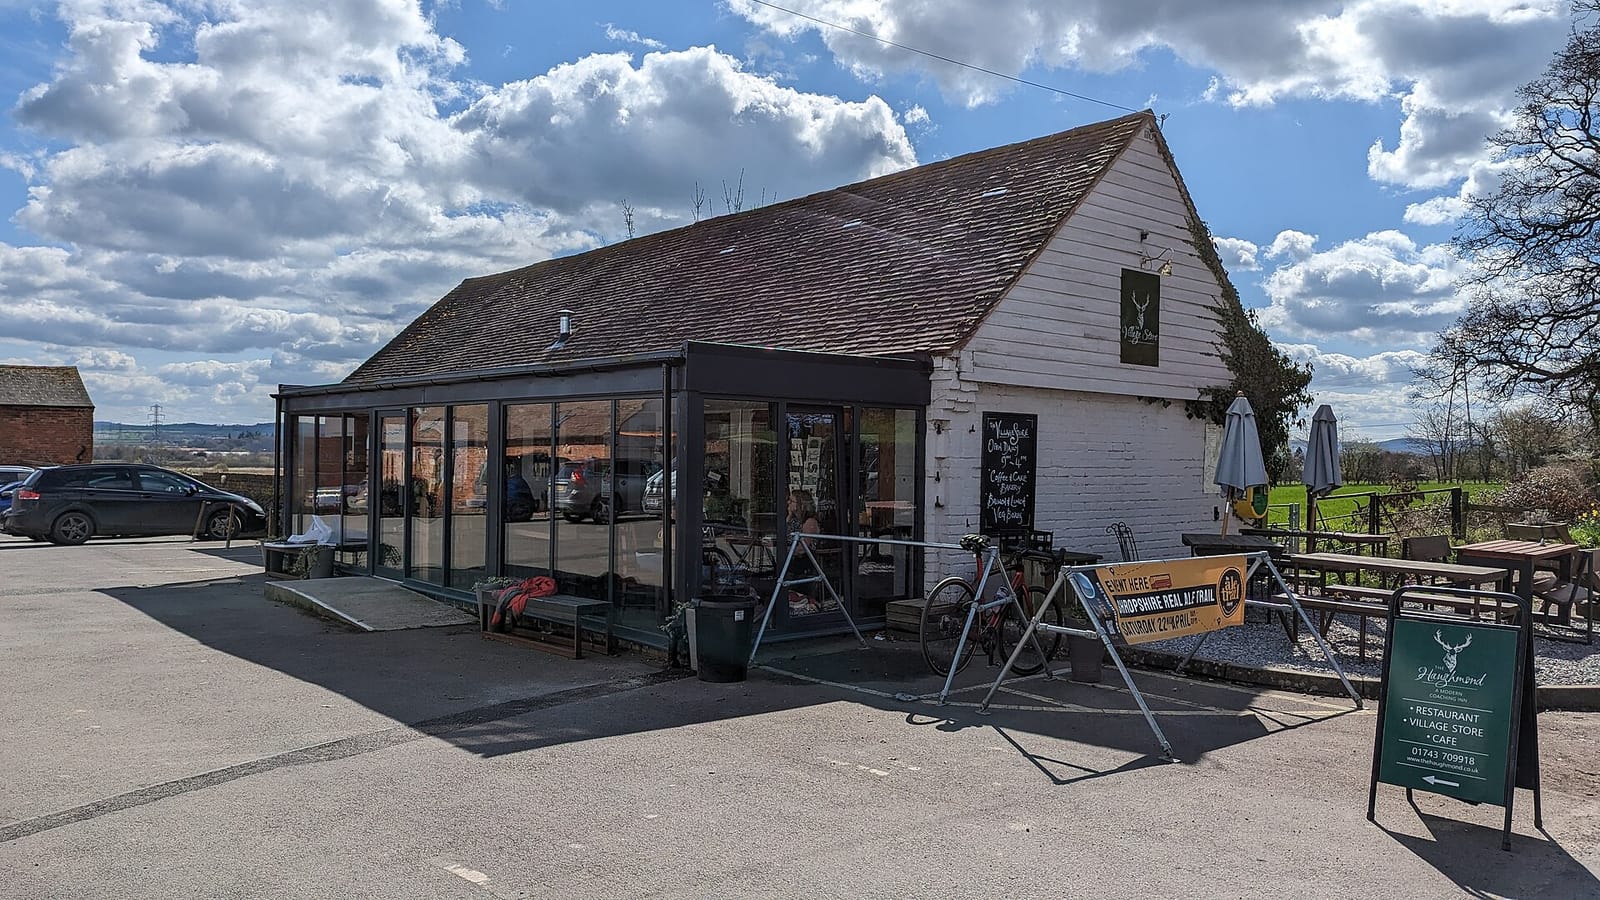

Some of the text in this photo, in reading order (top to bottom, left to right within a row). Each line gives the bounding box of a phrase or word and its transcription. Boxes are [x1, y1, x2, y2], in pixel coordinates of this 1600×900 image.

[1128, 576, 1149, 592] HERE
[1163, 592, 1183, 608] REAL
[1184, 590, 1195, 606] ALE
[1196, 588, 1215, 604] TRAIL
[1120, 617, 1157, 636] SATURDAY
[1414, 665, 1488, 689] Haughmond
[1415, 705, 1480, 724] RESTAURANT
[1409, 717, 1485, 738] VILLAGE STORE
[1431, 733, 1458, 747] CAFE
[1406, 756, 1480, 774] www.thehaughmond.co.uk
[1411, 746, 1476, 767] 01743 709918
